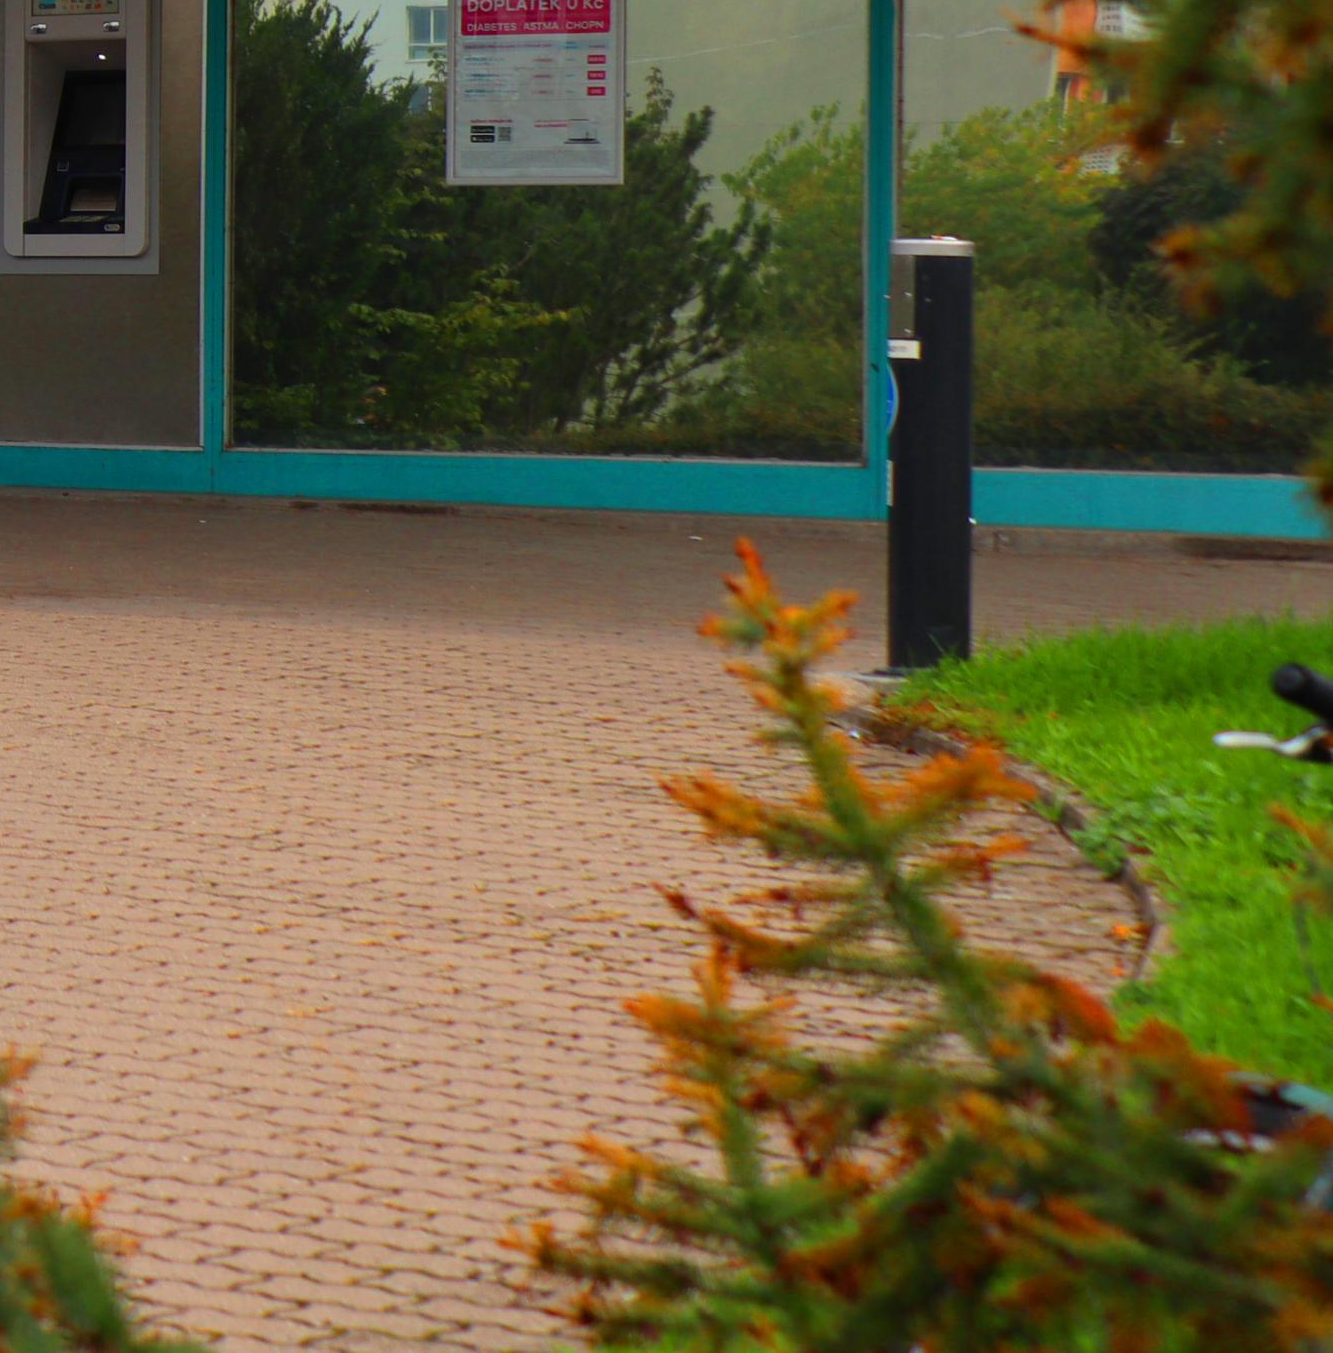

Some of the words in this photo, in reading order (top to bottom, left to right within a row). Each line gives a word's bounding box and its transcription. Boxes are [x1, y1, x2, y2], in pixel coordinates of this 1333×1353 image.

[467, 22, 517, 32] DIABETES
[523, 20, 559, 31] ASTMA
[565, 20, 604, 30] CHOPN
